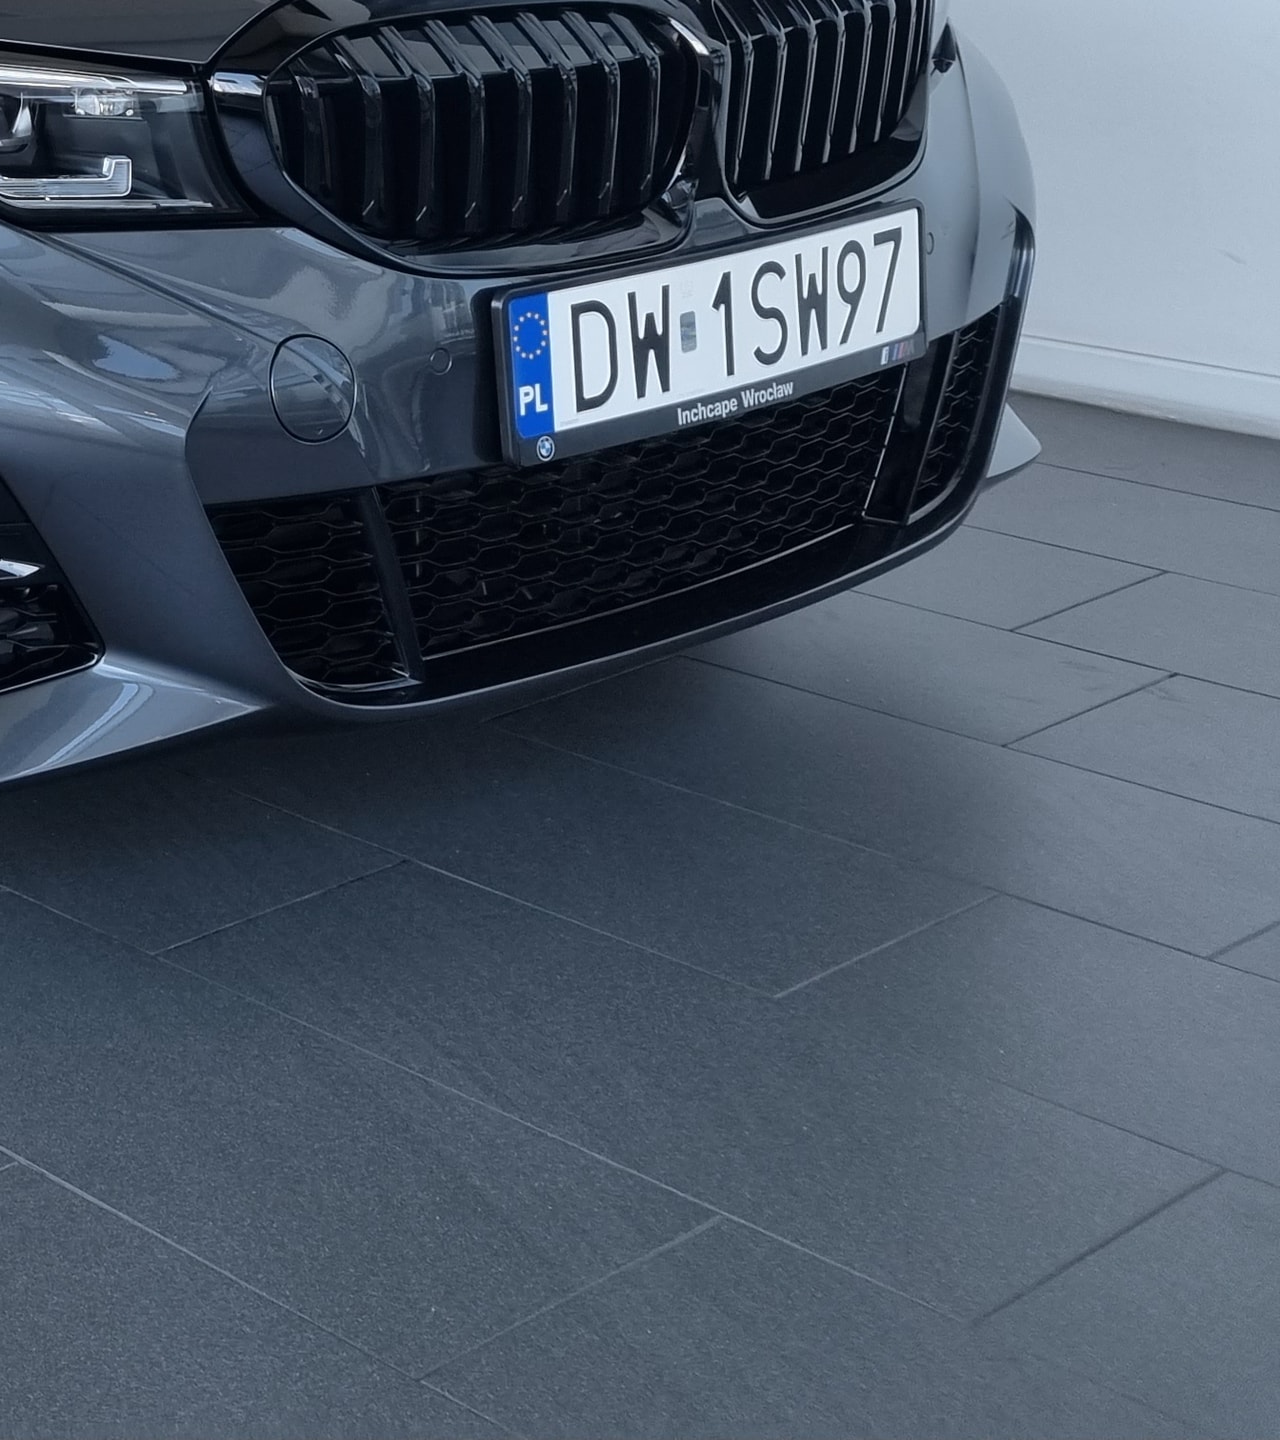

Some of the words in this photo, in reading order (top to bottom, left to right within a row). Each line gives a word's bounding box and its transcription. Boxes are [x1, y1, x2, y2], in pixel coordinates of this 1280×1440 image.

[570, 283, 672, 414] DW
[710, 226, 904, 377] 1SW97
[518, 384, 549, 417] PL
[676, 397, 738, 426] Inchcape
[741, 381, 794, 409] Wrocław
